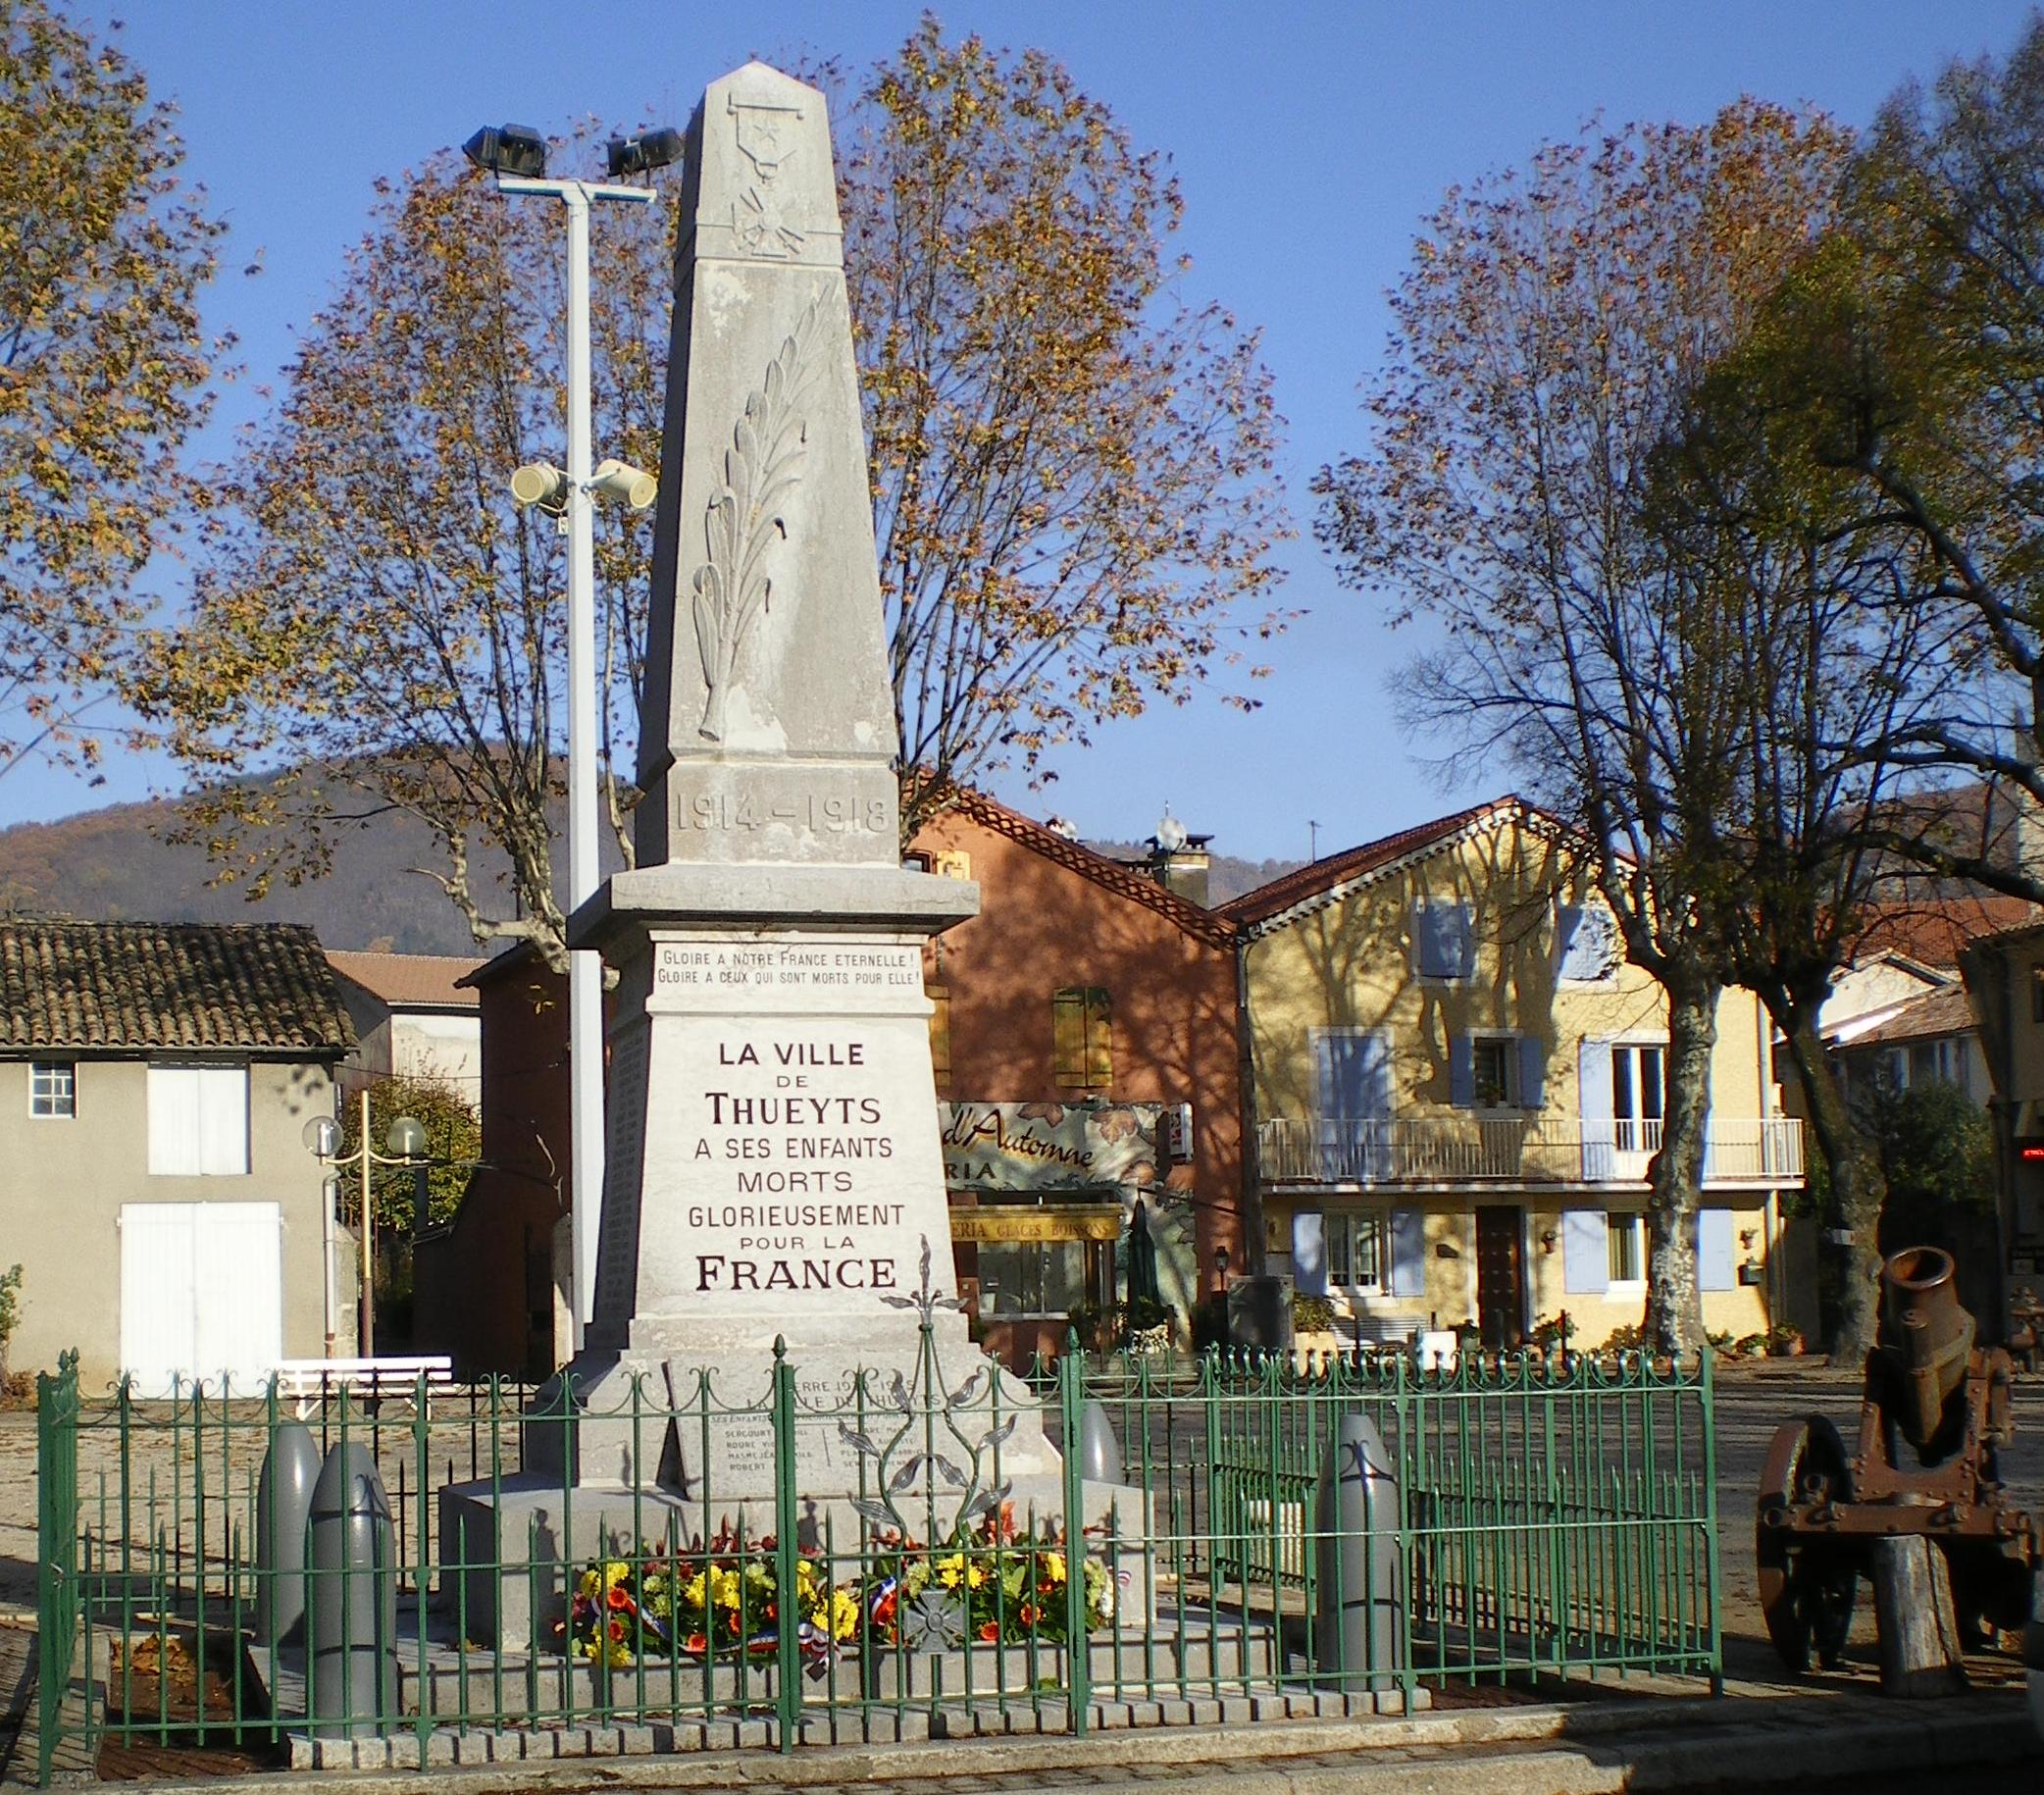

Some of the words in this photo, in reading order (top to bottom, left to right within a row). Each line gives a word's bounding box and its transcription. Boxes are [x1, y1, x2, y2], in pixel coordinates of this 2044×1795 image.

[663, 949, 710, 965] GLOIRE
[733, 953, 774, 965] NOTRE
[781, 950, 828, 966] FRANCE
[658, 968, 698, 984] GLOIRE
[719, 970, 749, 984] CEUX
[755, 972, 773, 985] QUI
[780, 971, 806, 985] SONT
[812, 972, 848, 985] MORTS
[855, 972, 883, 985] POUR
[719, 1043, 760, 1065] LA
[774, 1043, 864, 1066] VILLE
[776, 1075, 809, 1088] DE
[704, 1092, 882, 1125] THUEYTS
[694, 1138, 712, 1159] A
[726, 1138, 771, 1159] SES
[787, 1137, 893, 1158] ENFANTS
[738, 1171, 853, 1193] MORTS
[689, 1205, 905, 1227] GLORIEUSEMENT
[996, 1223, 1043, 1238] GLACES
[740, 1236, 805, 1251] POUR
[824, 1236, 856, 1250] LA
[695, 1256, 896, 1292] FRANCE
